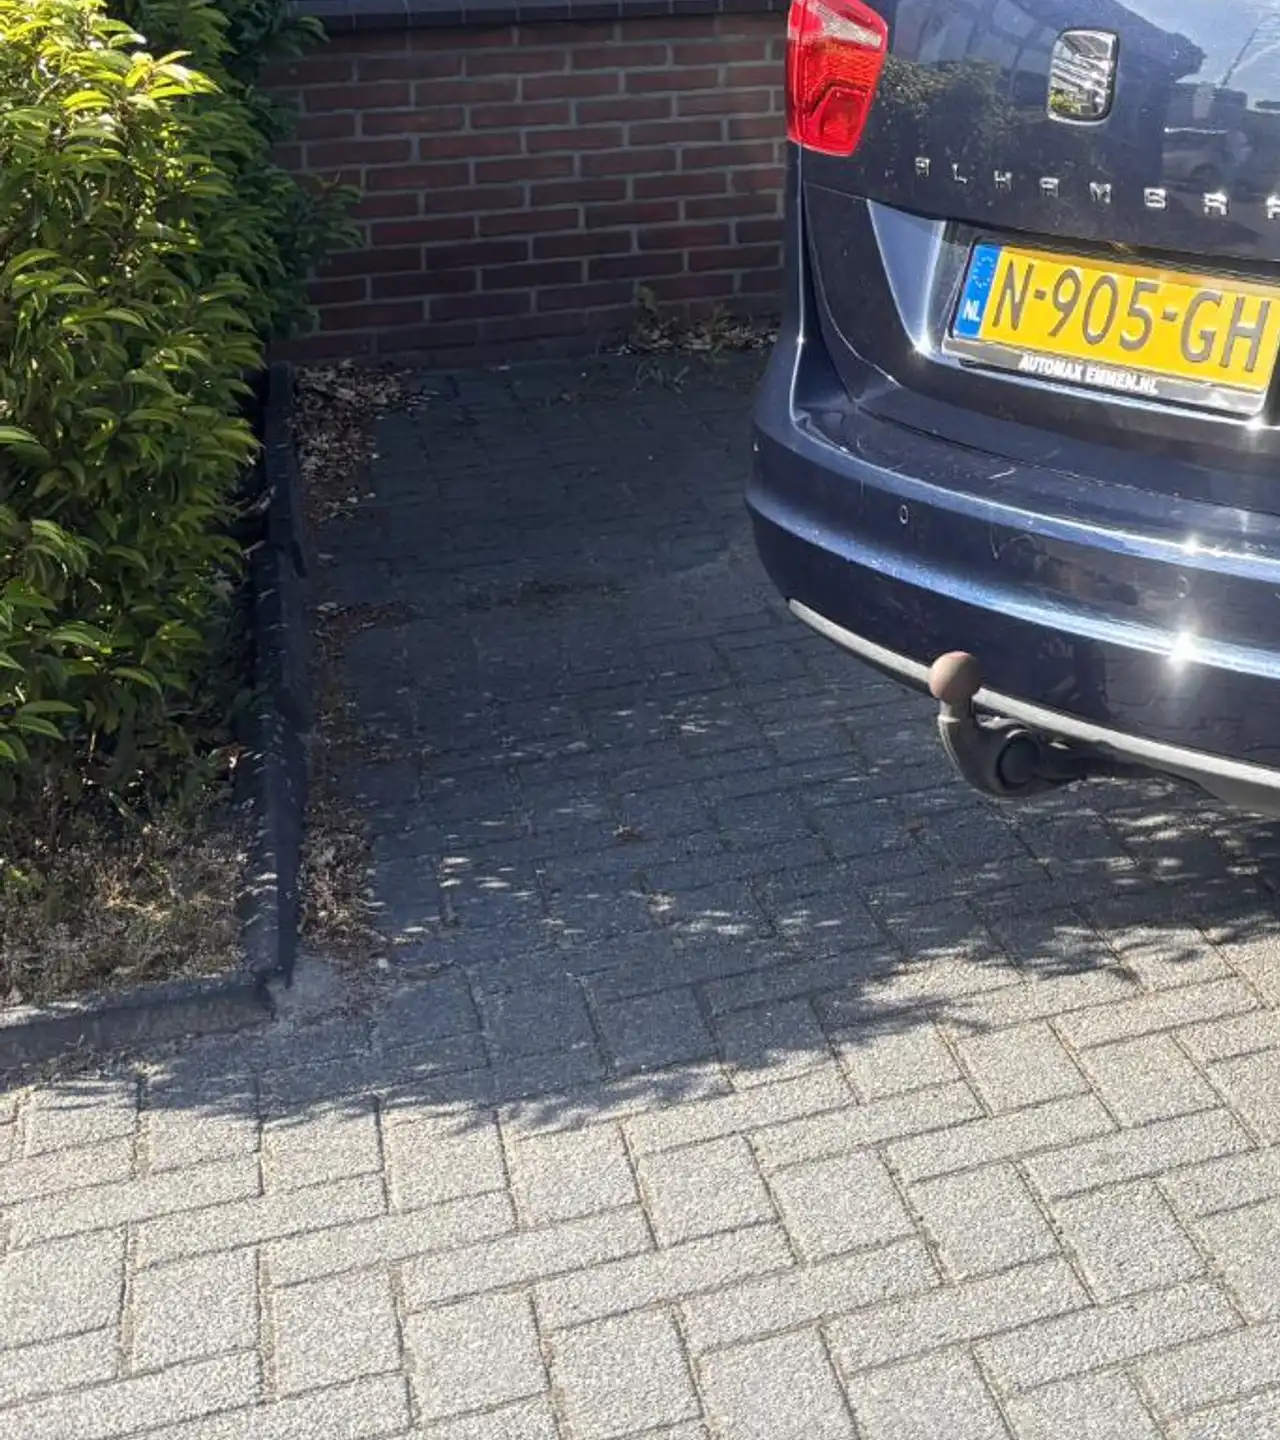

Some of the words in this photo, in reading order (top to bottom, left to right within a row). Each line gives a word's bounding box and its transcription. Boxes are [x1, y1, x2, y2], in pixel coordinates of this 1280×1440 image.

[963, 298, 981, 322] NL
[991, 259, 1272, 373] N-905-GH
[1018, 352, 1083, 380] AUTOMAX
[1086, 364, 1159, 396] EMMEN.NL
